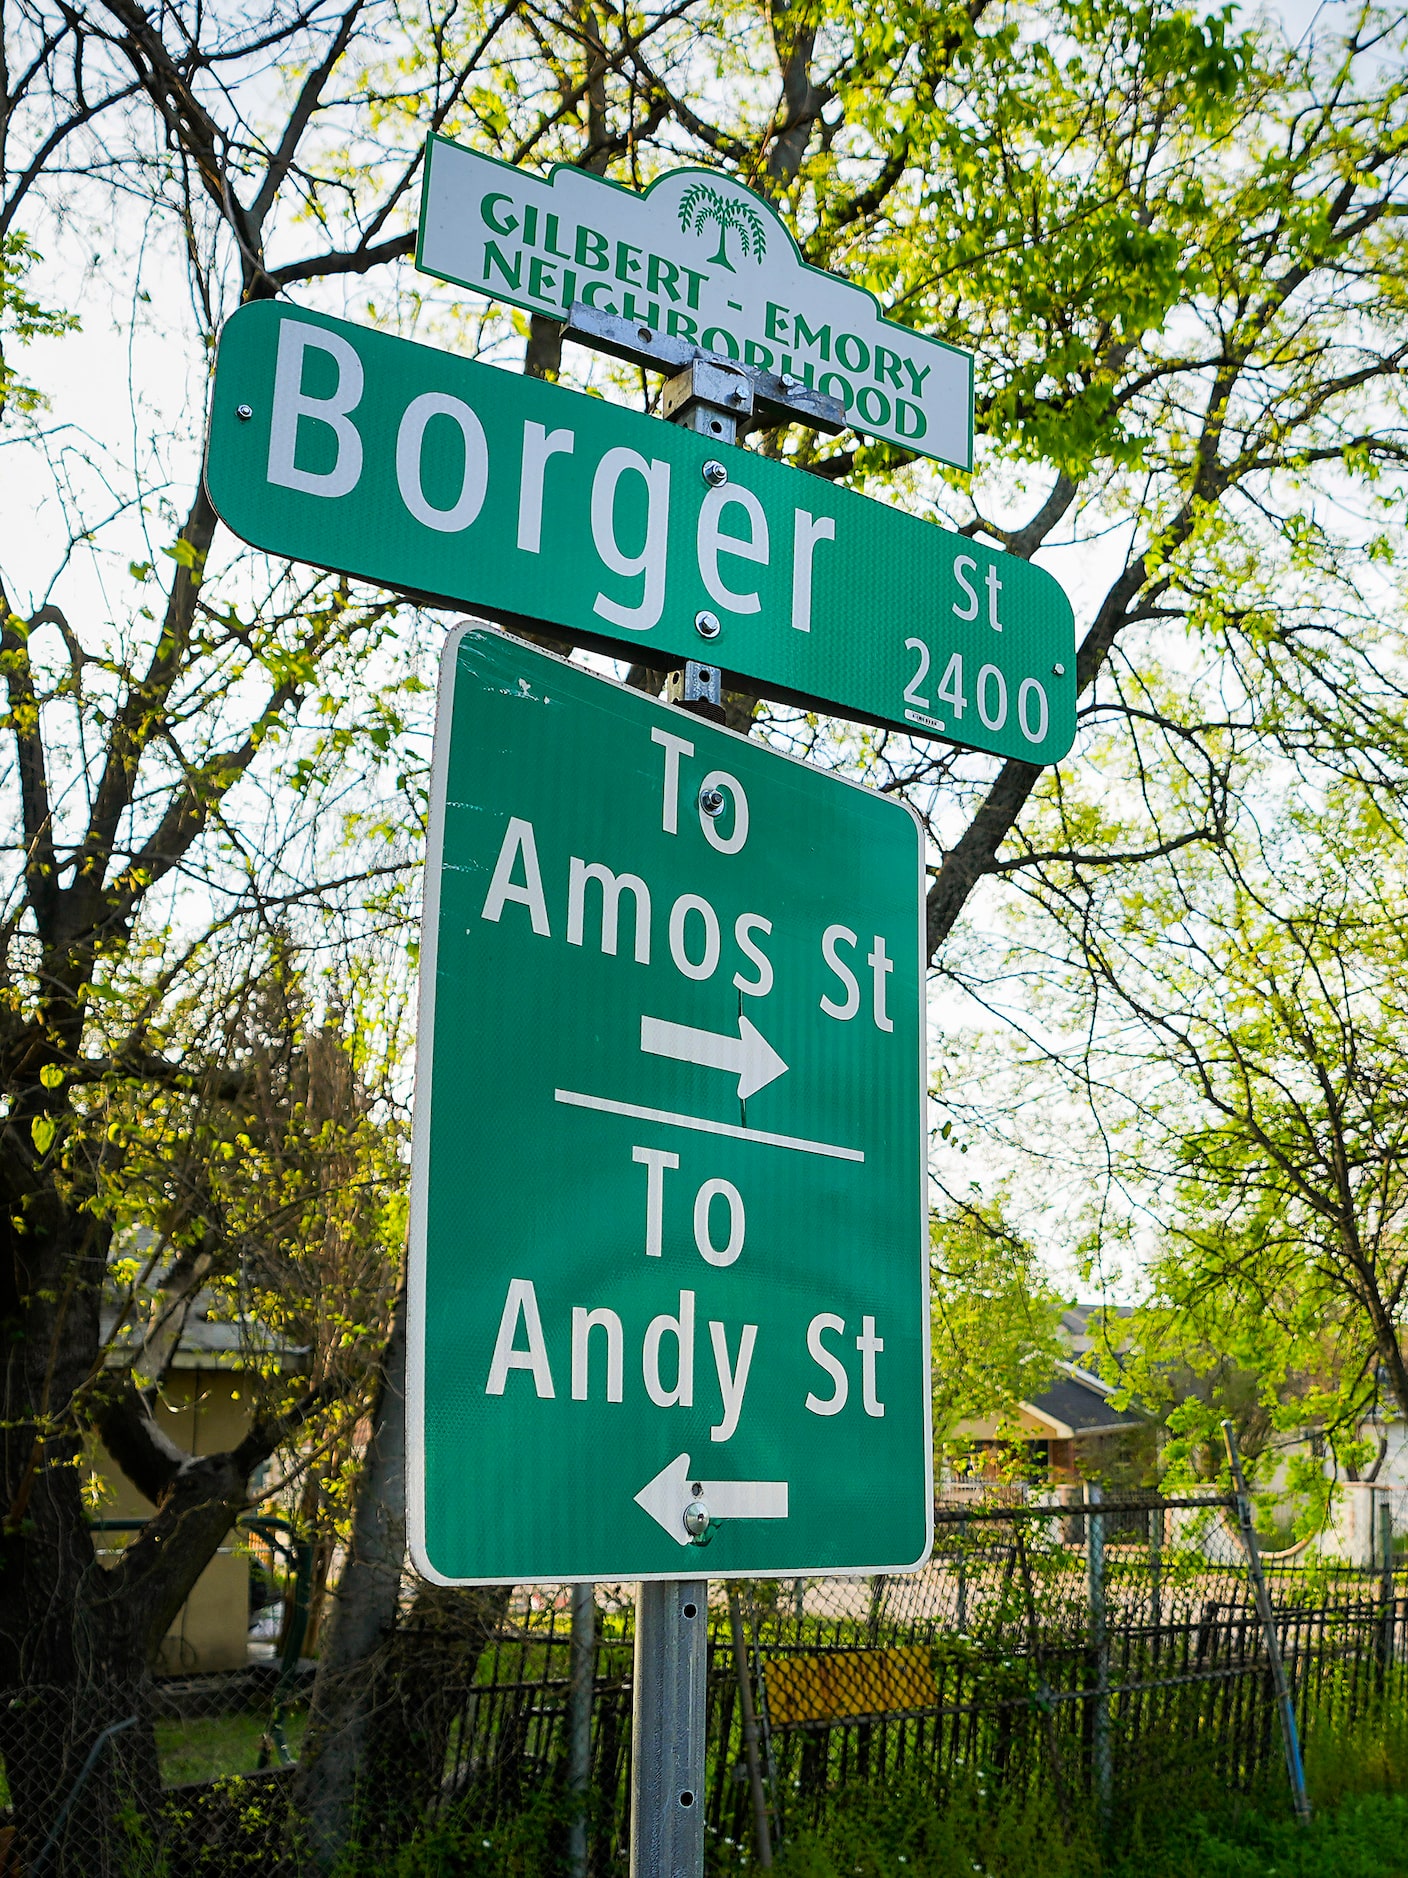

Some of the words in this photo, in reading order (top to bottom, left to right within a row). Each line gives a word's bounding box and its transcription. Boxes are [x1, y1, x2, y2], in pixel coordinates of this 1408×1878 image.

[480, 191, 710, 311] GILBERT
[764, 301, 931, 399] EMORY
[266, 318, 836, 634] Borger
[951, 554, 1003, 633] St
[903, 637, 1049, 744] 2400
[650, 726, 750, 855] To
[481, 816, 774, 997] Amos
[819, 924, 894, 1033] St
[632, 1145, 746, 1267] To
[485, 1277, 758, 1443] Andy
[804, 1312, 885, 1418] St
